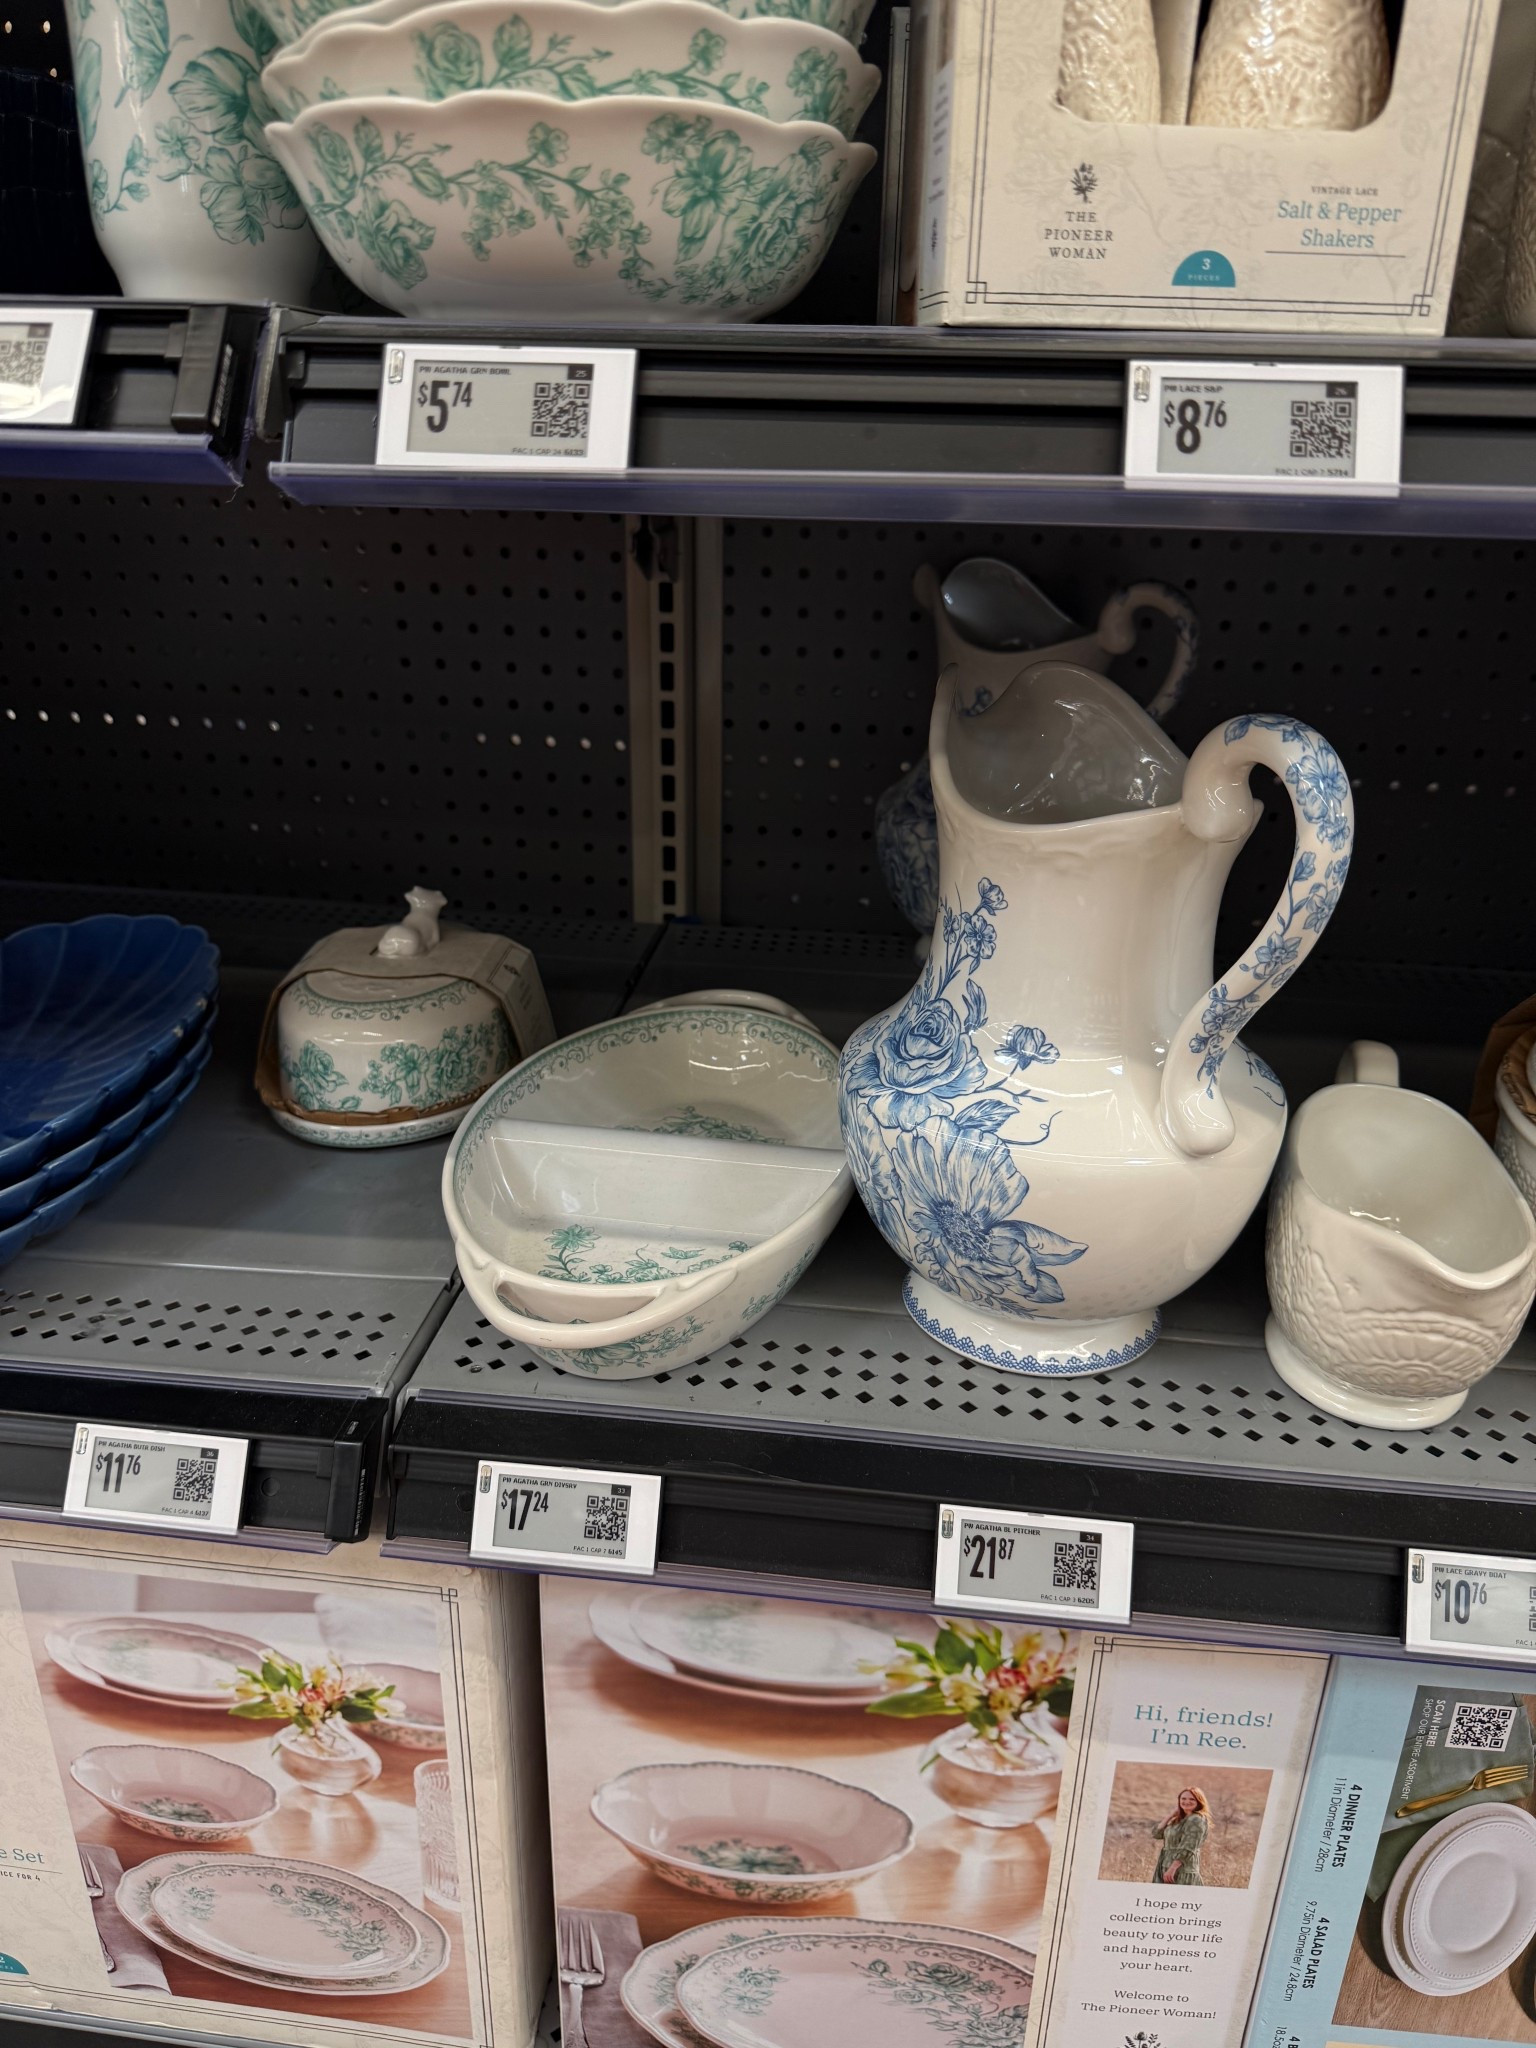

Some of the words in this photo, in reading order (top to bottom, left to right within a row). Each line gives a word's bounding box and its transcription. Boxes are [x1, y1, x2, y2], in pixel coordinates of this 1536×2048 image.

[1312, 186, 1352, 195] VINTAGE
[1355, 187, 1378, 196] LACE
[1066, 211, 1097, 222] THE
[1277, 200, 1314, 219] Salt
[1318, 202, 1331, 220] &
[1336, 202, 1402, 226] Pepper
[1044, 228, 1114, 242] PIONEER
[1300, 228, 1375, 248] Shakers
[1048, 247, 1107, 260] WOMAN
[1202, 258, 1210, 270] 3
[108, 1441, 132, 1449] AGATHA
[513, 1477, 539, 1485] AGATHA
[975, 1523, 1002, 1532] AGATHA
[1013, 1528, 1041, 1536] PITCHER
[1086, 1534, 1095, 1542] 34
[1464, 1569, 1487, 1578] GRAVY
[1058, 1595, 1071, 1603] CAP
[1135, 1704, 1168, 1724] Hi,
[1176, 1706, 1273, 1728] friends!
[1422, 1698, 1433, 1718] SHOP
[1433, 1699, 1446, 1724] SCAN
[1418, 1719, 1429, 1735] OUR
[1197, 1731, 1247, 1749] Ree.
[1411, 1735, 1425, 1757] ENTIRE
[1333, 1777, 1347, 1795] 11in
[1401, 1757, 1418, 1800] ASSORTMENT
[1323, 1797, 1342, 1840] Diameter
[1340, 1794, 1360, 1832] DINNER
[13, 1848, 45, 1864] Set
[1332, 1834, 1351, 1868] PLATES
[1314, 1847, 1330, 1873] 28cm
[1135, 1898, 1141, 1907] I
[1144, 1898, 1178, 1912] hope
[1181, 1902, 1203, 1912] my
[1302, 1901, 1318, 1925] 9.75in
[1109, 1912, 1175, 1925] collection
[1178, 1916, 1222, 1929] brings
[1103, 1927, 1149, 1940] beauty
[1151, 1931, 1164, 1940] to
[1167, 1933, 1199, 1942] your
[1201, 1933, 1223, 1944] life
[1310, 1925, 1329, 1956] SALAD
[1103, 1944, 1128, 1954] and
[1132, 1944, 1201, 1958] happiness
[1204, 1951, 1217, 1959] to
[1293, 1926, 1311, 1964] Diameter
[1120, 1961, 1151, 1970] your
[1154, 1962, 1193, 1973] heart.
[1302, 1958, 1320, 1989] PLATES
[1283, 1972, 1300, 2002] 24.8cm
[1114, 1990, 1173, 2002] Welcome
[1176, 1994, 1189, 2003] to
[1081, 2002, 1106, 2012] The
[1109, 2004, 1160, 2016] Pioneer
[1163, 2008, 1217, 2019] Woman!
